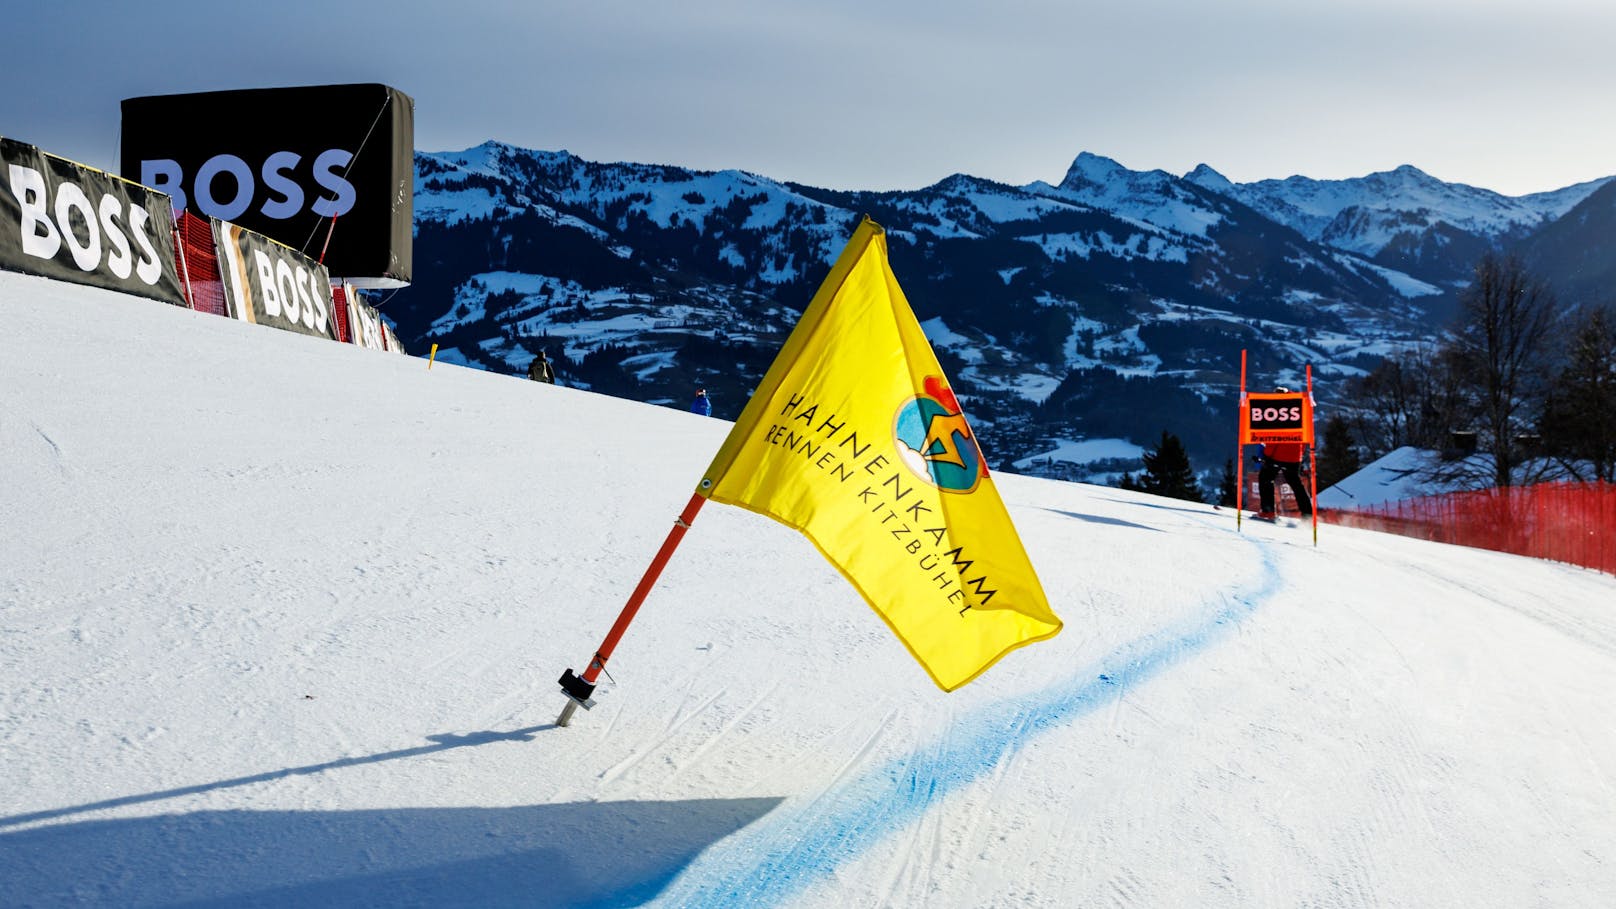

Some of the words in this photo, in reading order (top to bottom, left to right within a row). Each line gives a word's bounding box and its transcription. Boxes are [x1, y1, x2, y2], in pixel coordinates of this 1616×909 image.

[9, 164, 162, 285] BOSS
[141, 149, 356, 221] BOSS
[254, 249, 327, 334] BOSS
[1251, 407, 1301, 422] BOSS
[765, 424, 854, 482] RENNEN
[858, 487, 972, 618] KITZBÜHEL
[781, 393, 997, 605] HAHNENKAMM
